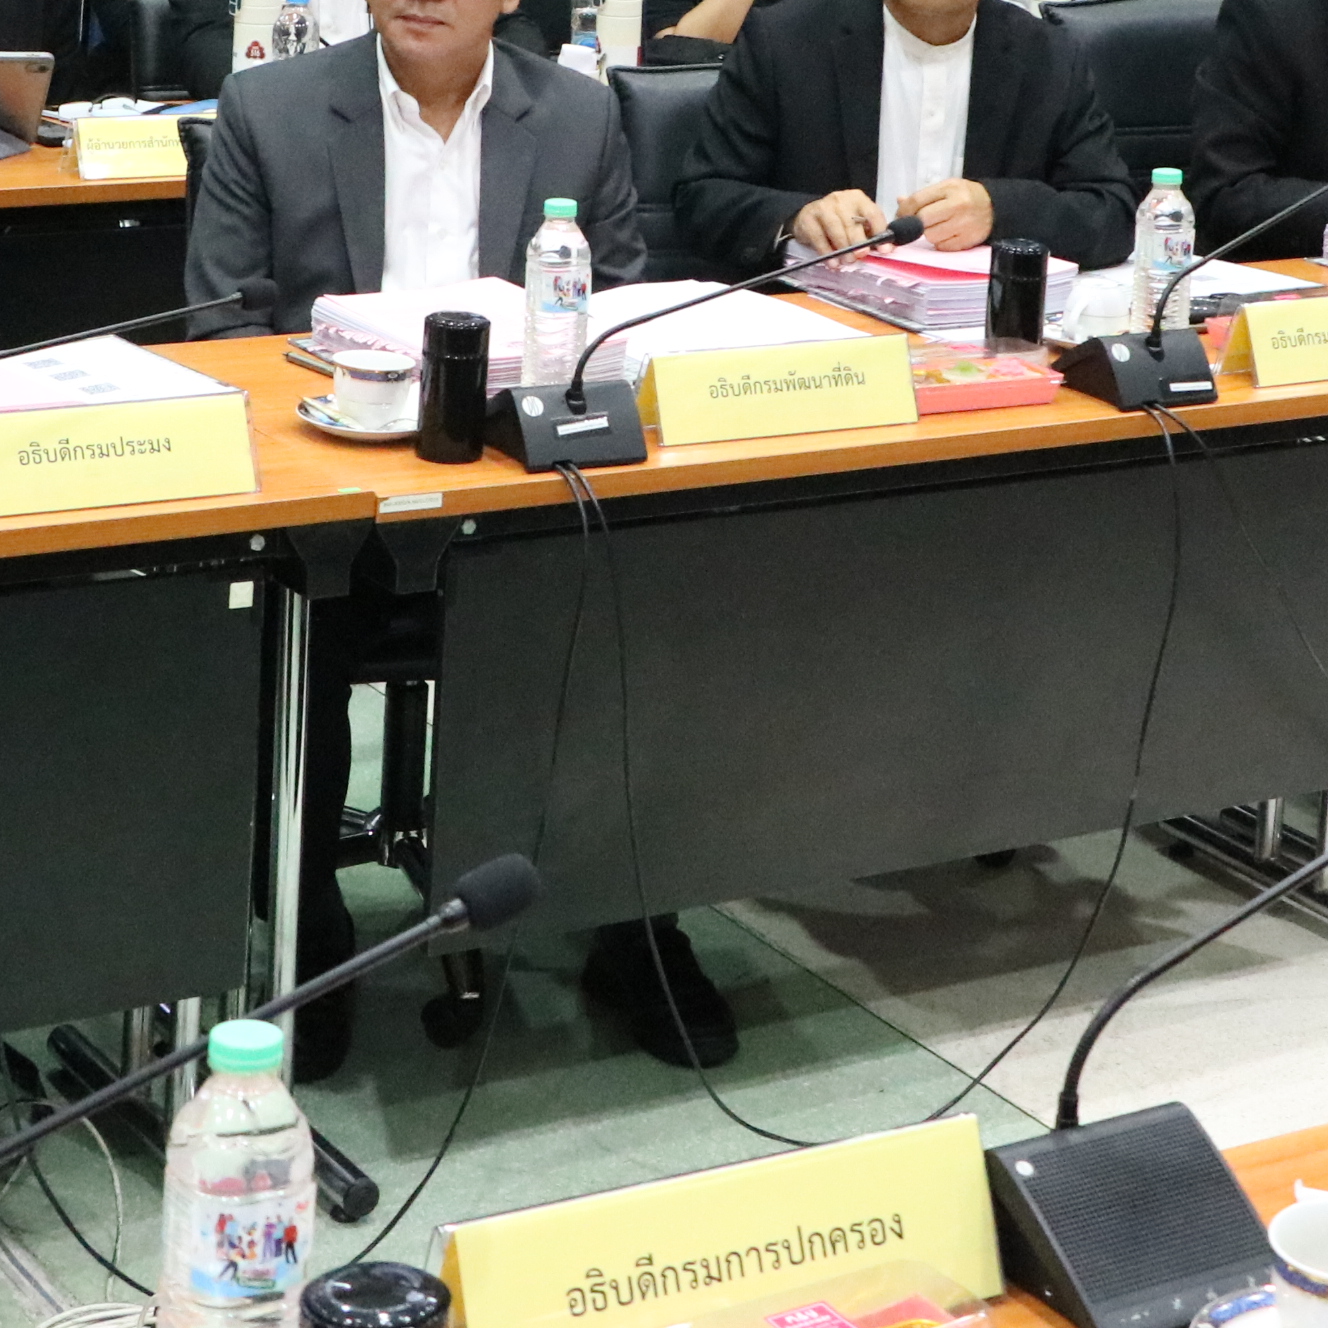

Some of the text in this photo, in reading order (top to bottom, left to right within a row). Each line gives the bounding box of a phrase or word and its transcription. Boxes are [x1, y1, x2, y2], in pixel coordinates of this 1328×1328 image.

[709, 362, 866, 399] อธิบดีกรมพัฒนาที่ดิน
[18, 435, 172, 466] อธิบดีกรมประมง
[565, 1213, 906, 1318] อธิบดีกรมการปกครอง
